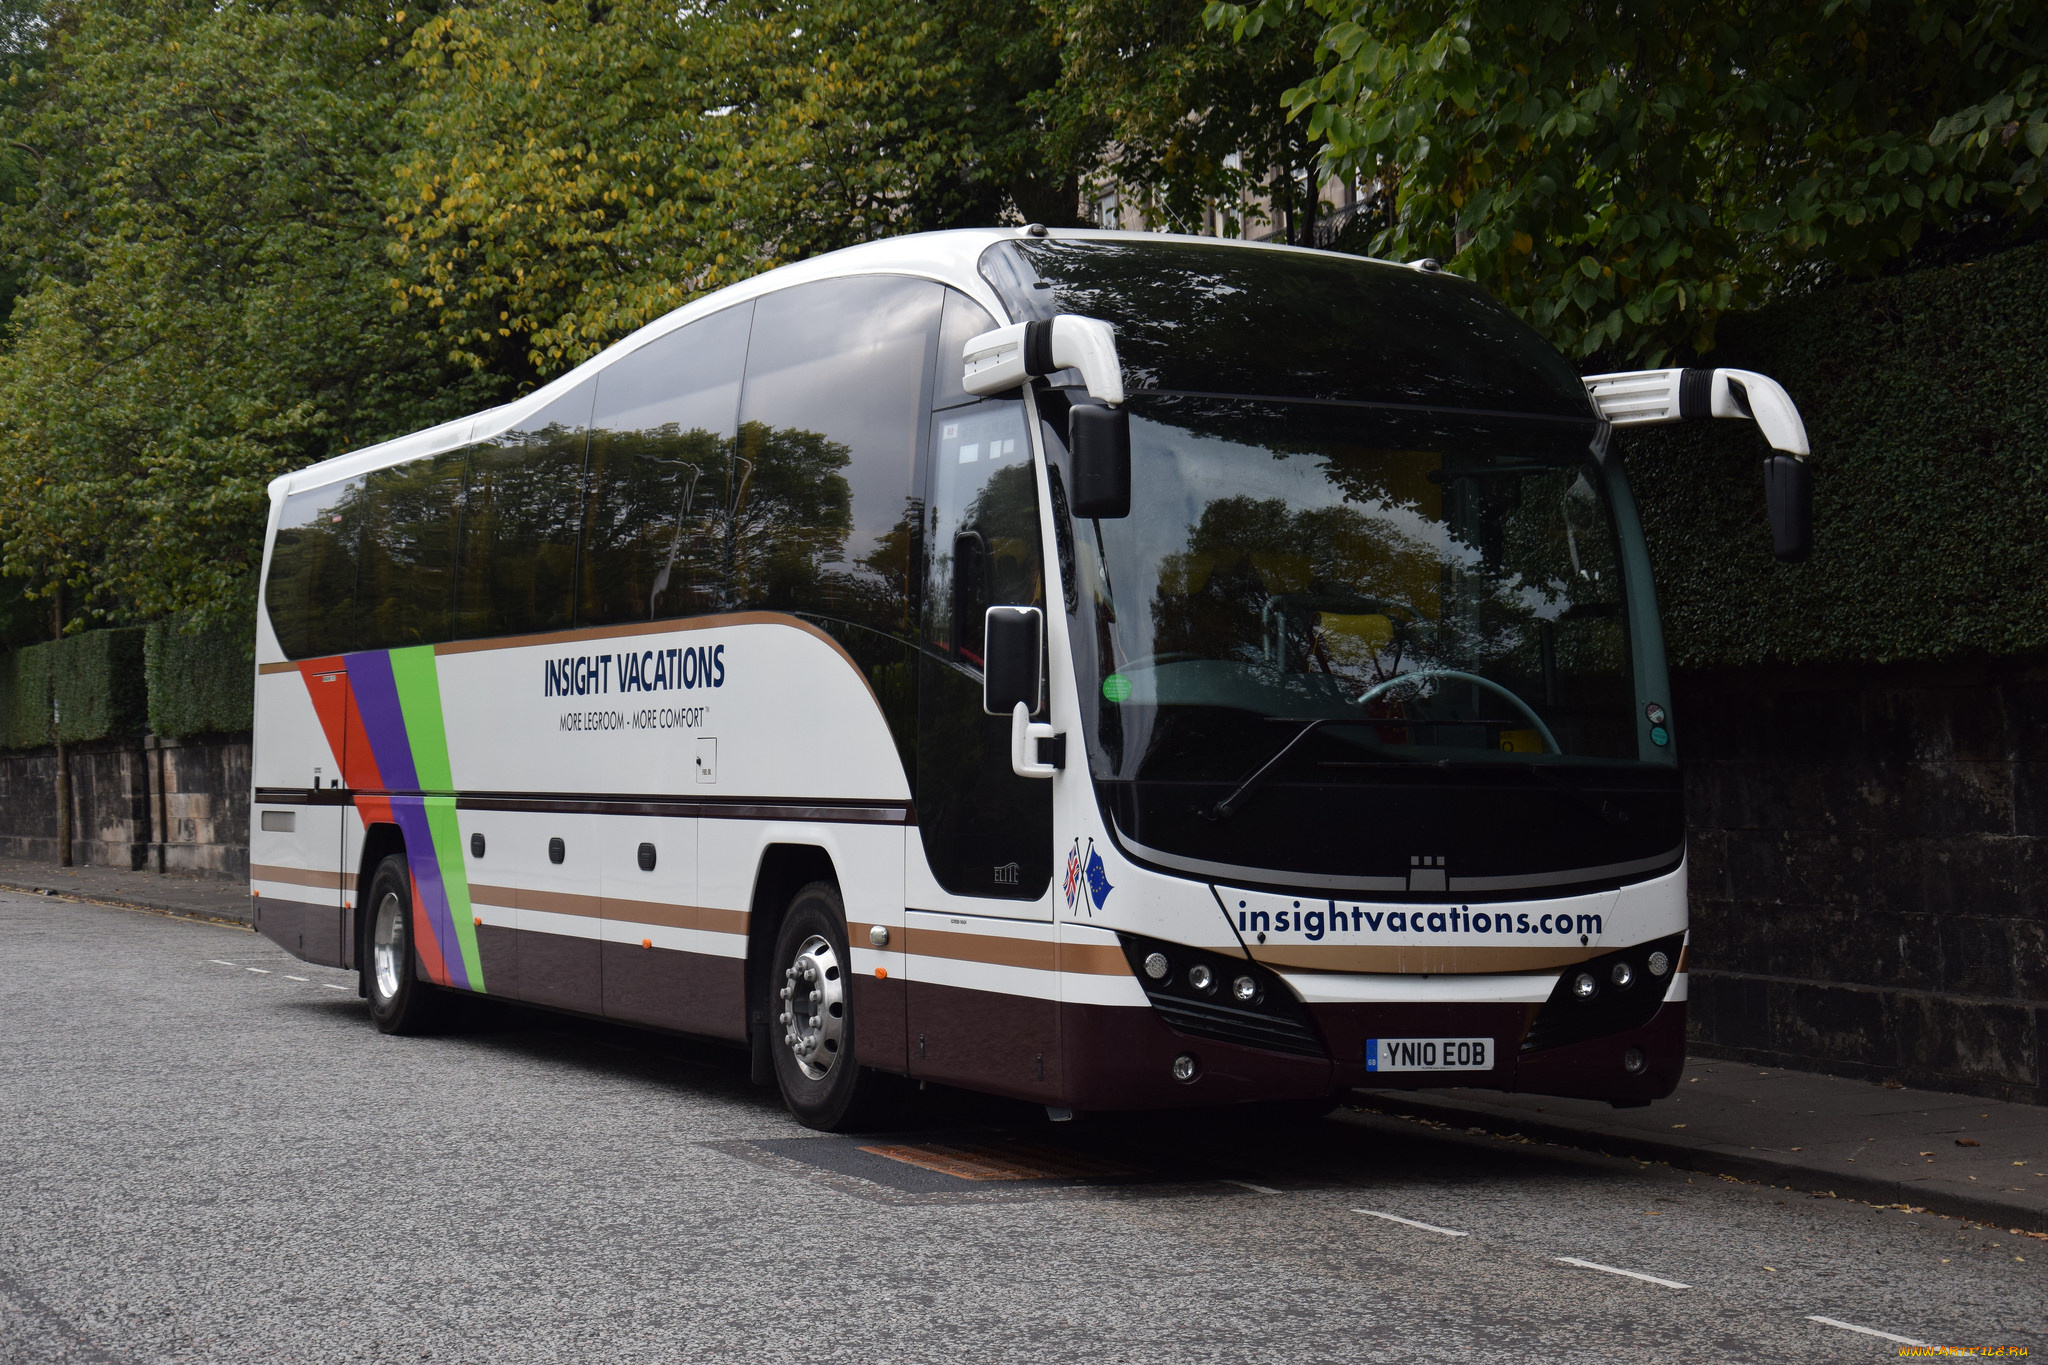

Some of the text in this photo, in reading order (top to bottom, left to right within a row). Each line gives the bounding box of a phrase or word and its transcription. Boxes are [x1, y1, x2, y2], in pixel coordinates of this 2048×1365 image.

[544, 644, 725, 697] INSIGHT VACATIONS
[559, 712, 582, 731] MORE
[584, 711, 625, 731] LEGROOM
[632, 709, 657, 730] MORE
[994, 862, 1019, 884] ELITE
[1239, 900, 1602, 941] insightvacations.com
[1386, 1042, 1485, 1066] YN10 EOB
